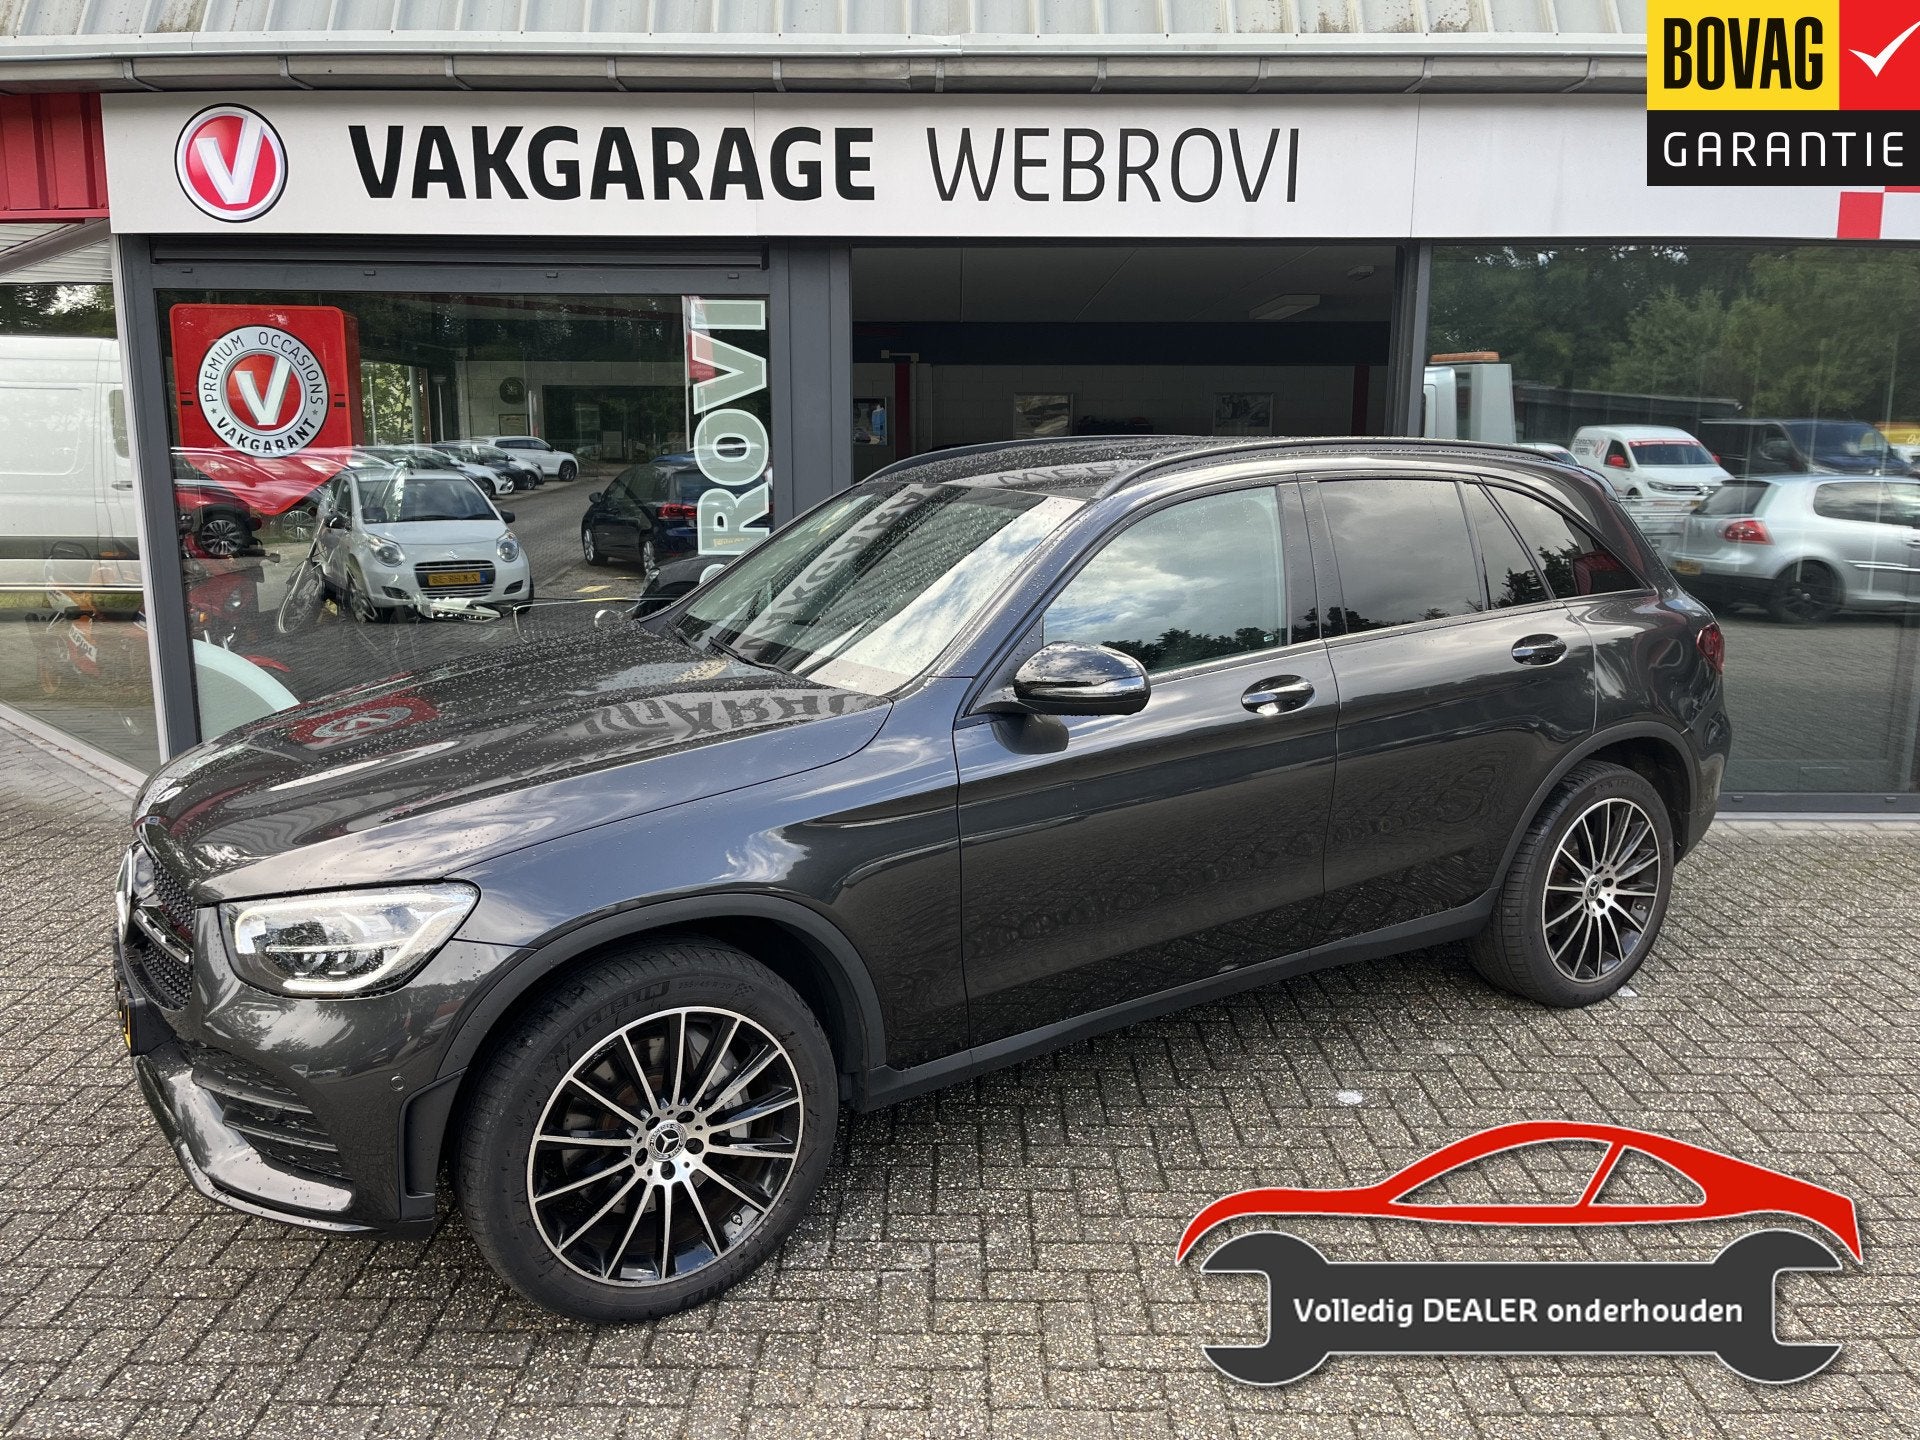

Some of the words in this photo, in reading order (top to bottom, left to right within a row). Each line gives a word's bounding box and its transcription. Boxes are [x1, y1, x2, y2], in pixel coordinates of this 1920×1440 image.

[349, 126, 875, 201] VAKGARAGE
[927, 128, 1299, 202] WEBROVI
[204, 334, 246, 403] PREMIUM
[258, 331, 324, 405] OCCASIONS
[216, 417, 316, 453] VAKGARANT
